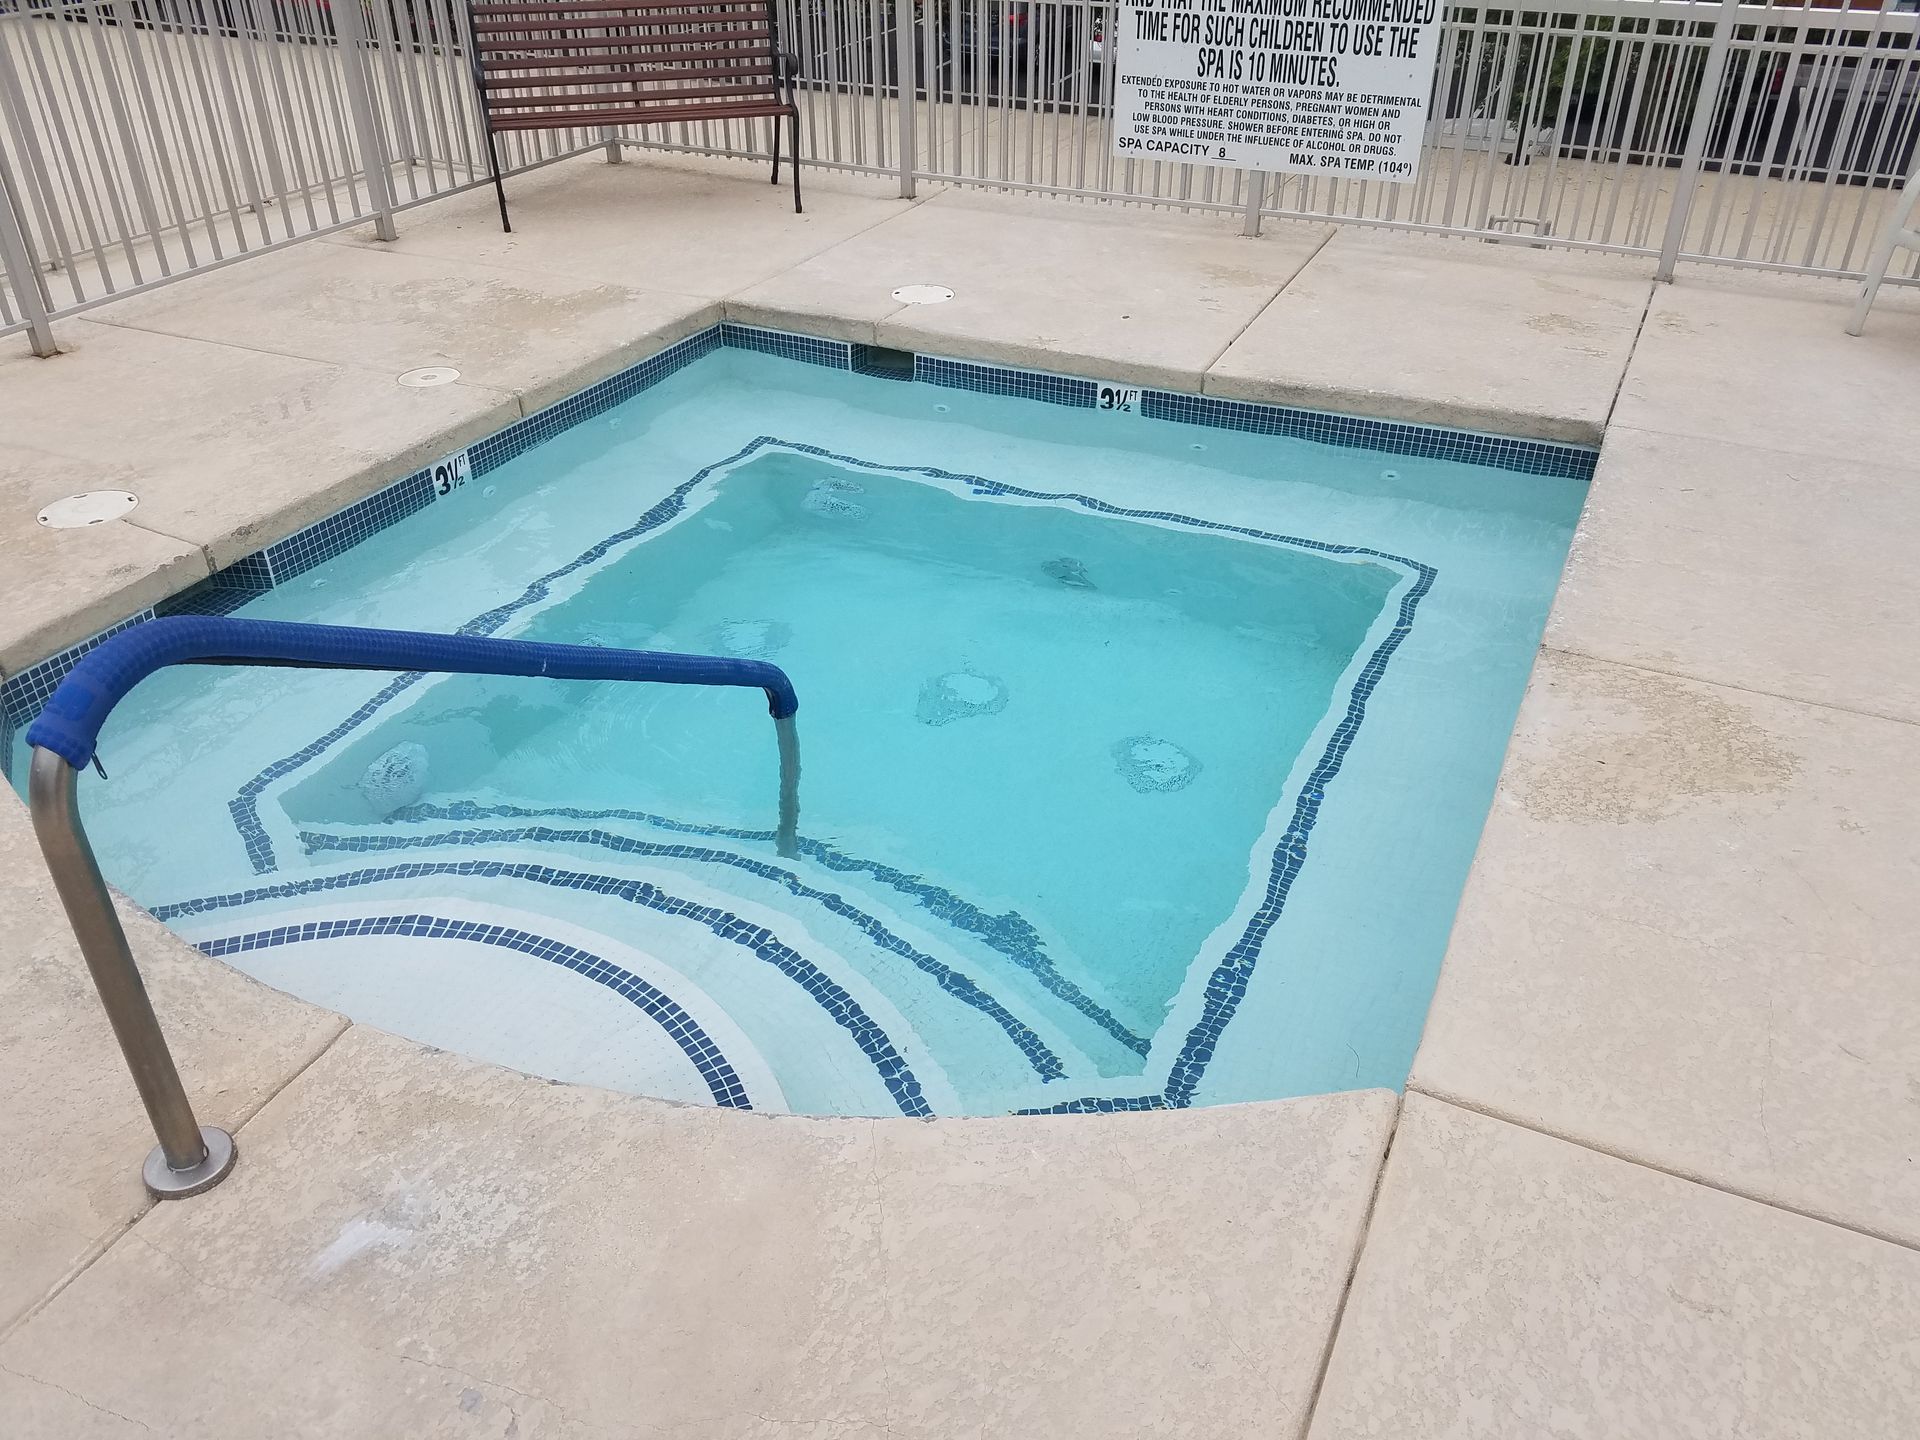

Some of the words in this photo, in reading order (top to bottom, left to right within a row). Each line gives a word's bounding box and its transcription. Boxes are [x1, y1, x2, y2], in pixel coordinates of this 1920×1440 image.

[1312, 0, 1436, 25] RECOMMENDED
[1135, 10, 1169, 42] TIME
[1172, 12, 1200, 44] FOR
[1205, 14, 1245, 47] SUCH
[1249, 17, 1325, 53] CHILDREN
[1329, 22, 1349, 55] TO
[1352, 24, 1386, 57] USE
[1389, 26, 1420, 59] THE
[1197, 48, 1224, 78] SPA
[1228, 50, 1244, 80] IS
[1248, 51, 1266, 82] 10
[1269, 52, 1340, 88] MINUTES.
[1121, 74, 1162, 87] EXTENDED
[1164, 78, 1208, 91] EXPOSURE
[1209, 82, 1220, 92] TO
[1222, 83, 1240, 94] HOT
[1241, 85, 1271, 97] WATER
[1273, 87, 1285, 97] OR
[1287, 88, 1323, 101] VAPORS
[1324, 91, 1345, 101] MAY
[1346, 93, 1358, 103] BE
[1360, 94, 1422, 108] DETRIMENTAL
[1138, 88, 1148, 98] TO
[1150, 89, 1166, 100] THE
[1167, 91, 1198, 103] HEALTH
[1200, 94, 1211, 104] OF
[1213, 95, 1249, 107] ELDERLY
[1251, 99, 1293, 112] PERSONS,
[1295, 101, 1343, 115] PREGNANT
[1344, 105, 1379, 117] WOMEN
[1381, 108, 1401, 119] AND
[1132, 112, 1150, 122] LOW
[1152, 114, 1178, 125] BLOOD
[1180, 117, 1225, 130] PRESSURE.
[1227, 122, 1264, 133] SHOWER
[1266, 125, 1299, 136] BEFORE
[1300, 128, 1344, 140] ENTERING
[1346, 130, 1366, 142] SPA.
[1368, 132, 1381, 142] DO
[1383, 134, 1402, 144] NOT
[1144, 101, 1182, 114] PERSONS
[1183, 104, 1205, 116] WITH
[1207, 106, 1234, 118] HEART
[1236, 110, 1290, 124] CONDITIONS,
[1292, 113, 1336, 127] DIABETES,
[1338, 117, 1351, 128] OR
[1353, 119, 1375, 130] HIGH
[1377, 120, 1391, 131] OR
[1118, 136, 1143, 150] SPA
[1146, 140, 1210, 156] CAPACITY
[1218, 147, 1226, 158] 8
[1134, 124, 1150, 135] USE
[1151, 126, 1167, 136] SPA
[1169, 128, 1195, 139] WHILE
[1196, 130, 1225, 142] UNDER
[1226, 133, 1242, 143] THE
[1244, 134, 1290, 148] INFLUENCE
[1292, 138, 1304, 149] OF
[1305, 140, 1346, 152] ALCOHOL
[1349, 143, 1361, 153] OR
[1363, 144, 1396, 157] DRUGS.
[1289, 153, 1316, 166] MAX.
[1320, 155, 1341, 168] SPA
[1344, 157, 1374, 171] TEMP.
[1129, 390, 1139, 401] FT
[458, 453, 466, 468] FT
